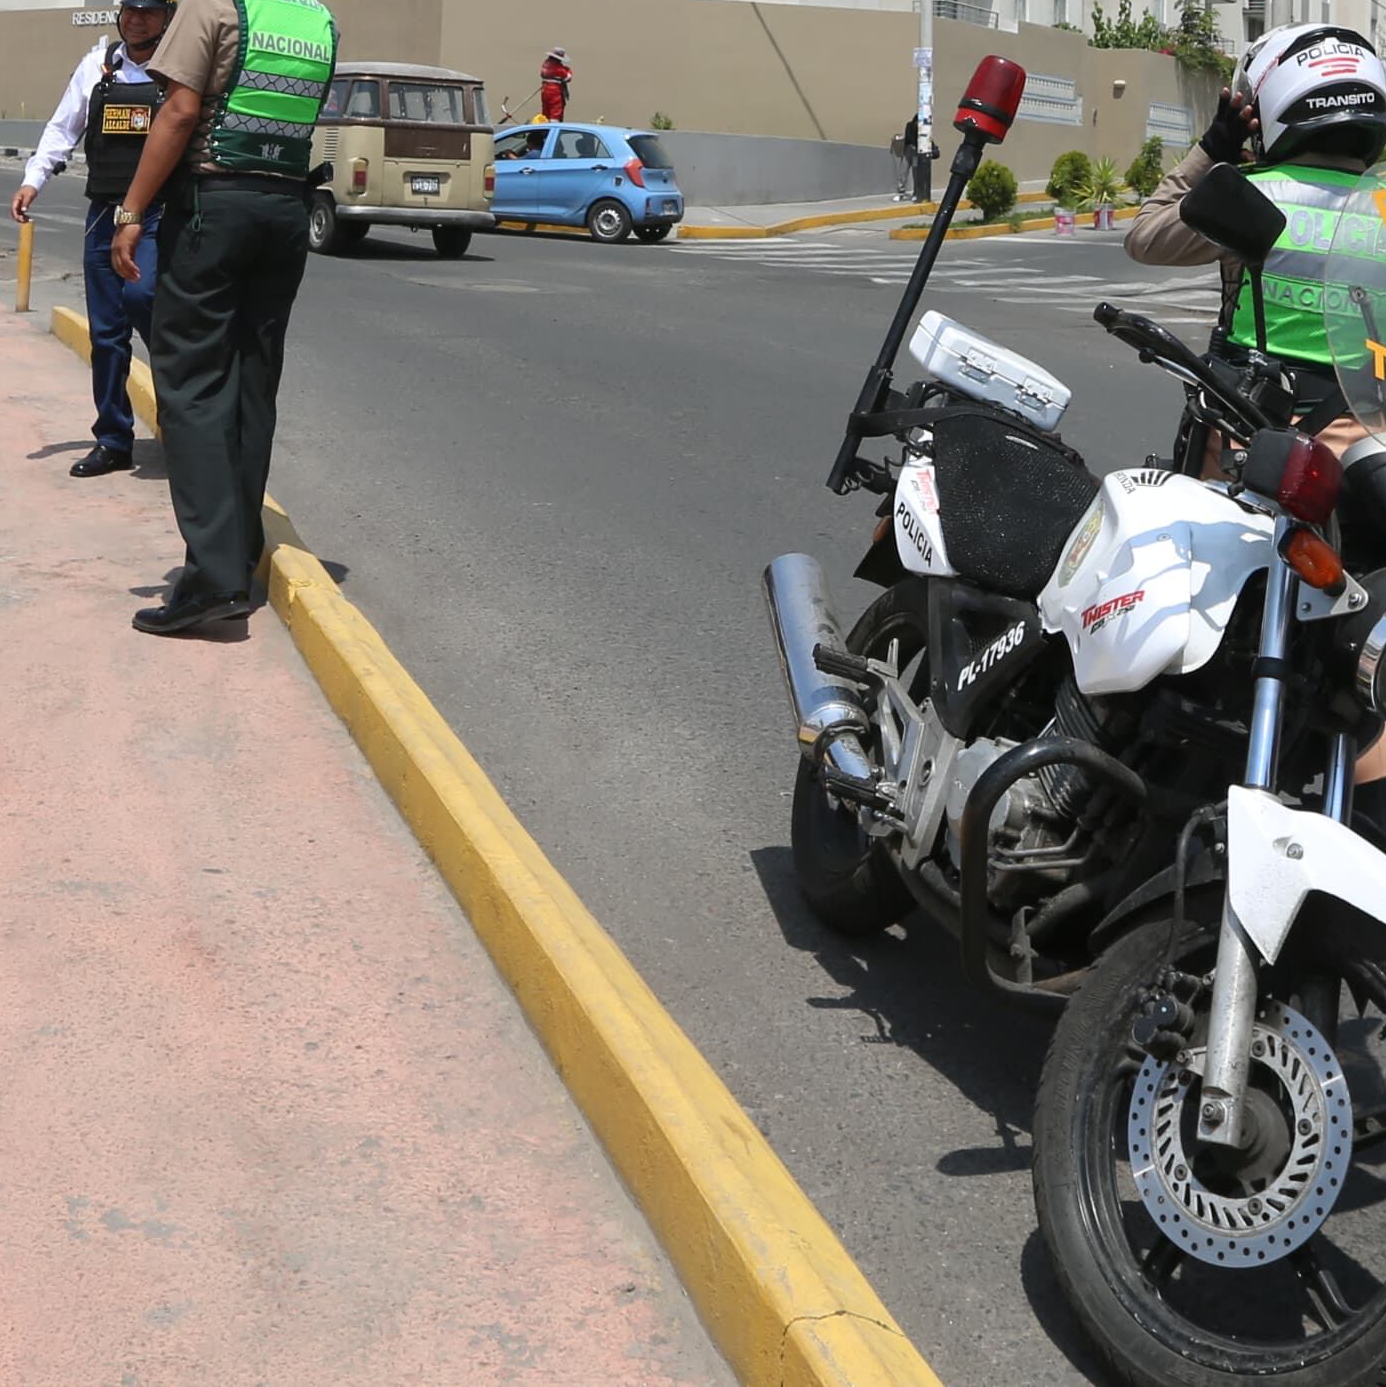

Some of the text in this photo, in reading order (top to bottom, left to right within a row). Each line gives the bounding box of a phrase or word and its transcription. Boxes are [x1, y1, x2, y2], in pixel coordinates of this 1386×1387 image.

[251, 31, 331, 62] NACIONAL
[1296, 43, 1365, 67] POLICIA
[1305, 92, 1376, 110] TRANSITO
[895, 501, 933, 568] POLICIA
[956, 620, 1026, 692] PL-17936
